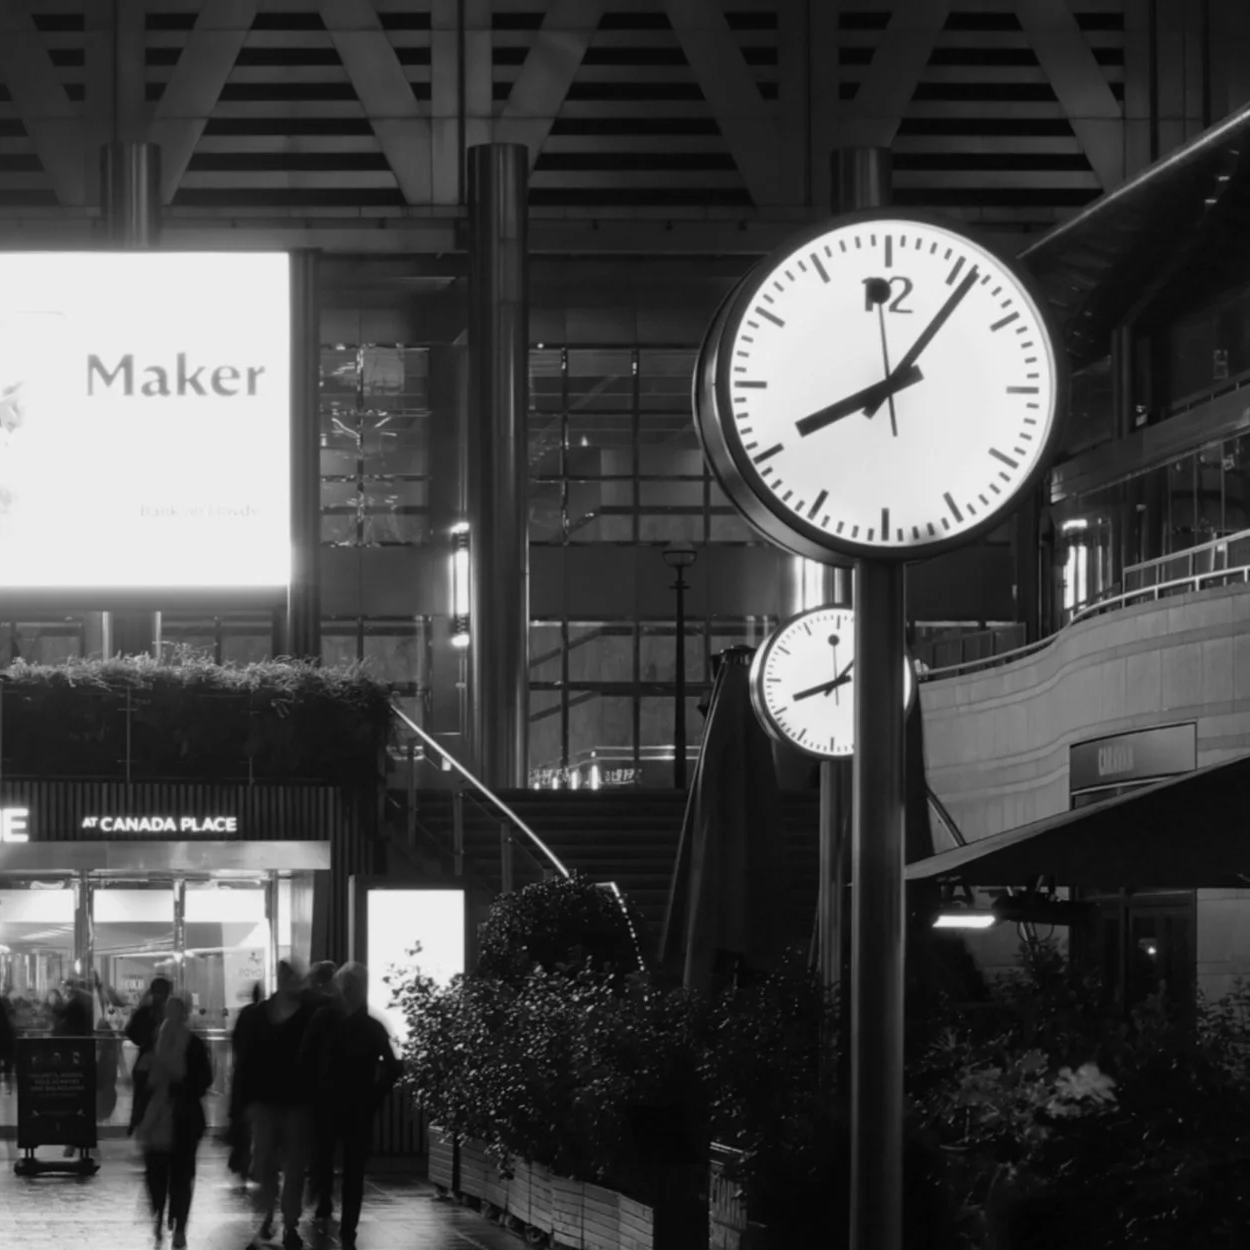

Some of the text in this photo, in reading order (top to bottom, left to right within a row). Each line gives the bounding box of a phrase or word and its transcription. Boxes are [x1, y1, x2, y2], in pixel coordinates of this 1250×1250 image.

[860, 275, 914, 314] 12
[86, 351, 267, 398] Maker
[81, 816, 238, 833] AT CANADA PLACE
